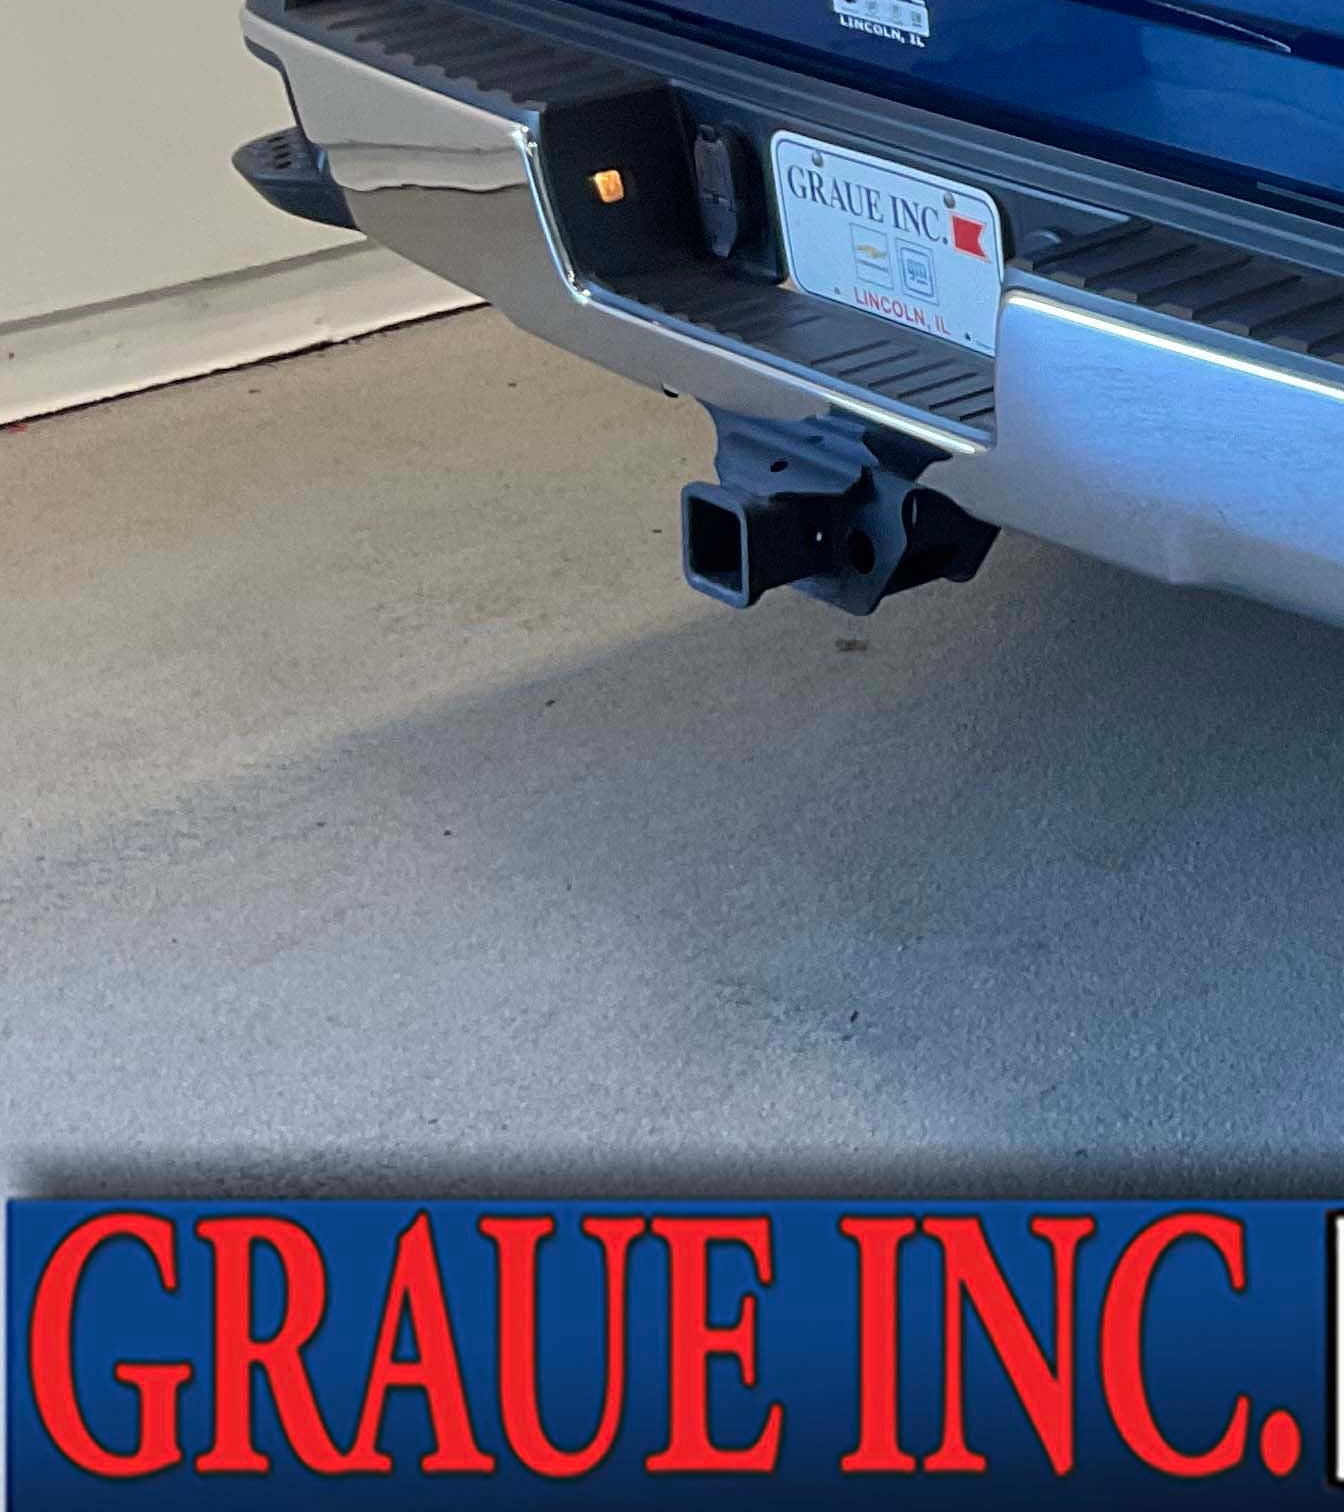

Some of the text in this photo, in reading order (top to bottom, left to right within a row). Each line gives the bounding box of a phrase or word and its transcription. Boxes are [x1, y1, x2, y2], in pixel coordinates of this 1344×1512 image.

[840, 14, 926, 48] LINCOLN, IL
[787, 164, 948, 245] GRAUE INC.
[853, 287, 951, 336] LINCOLN, IL
